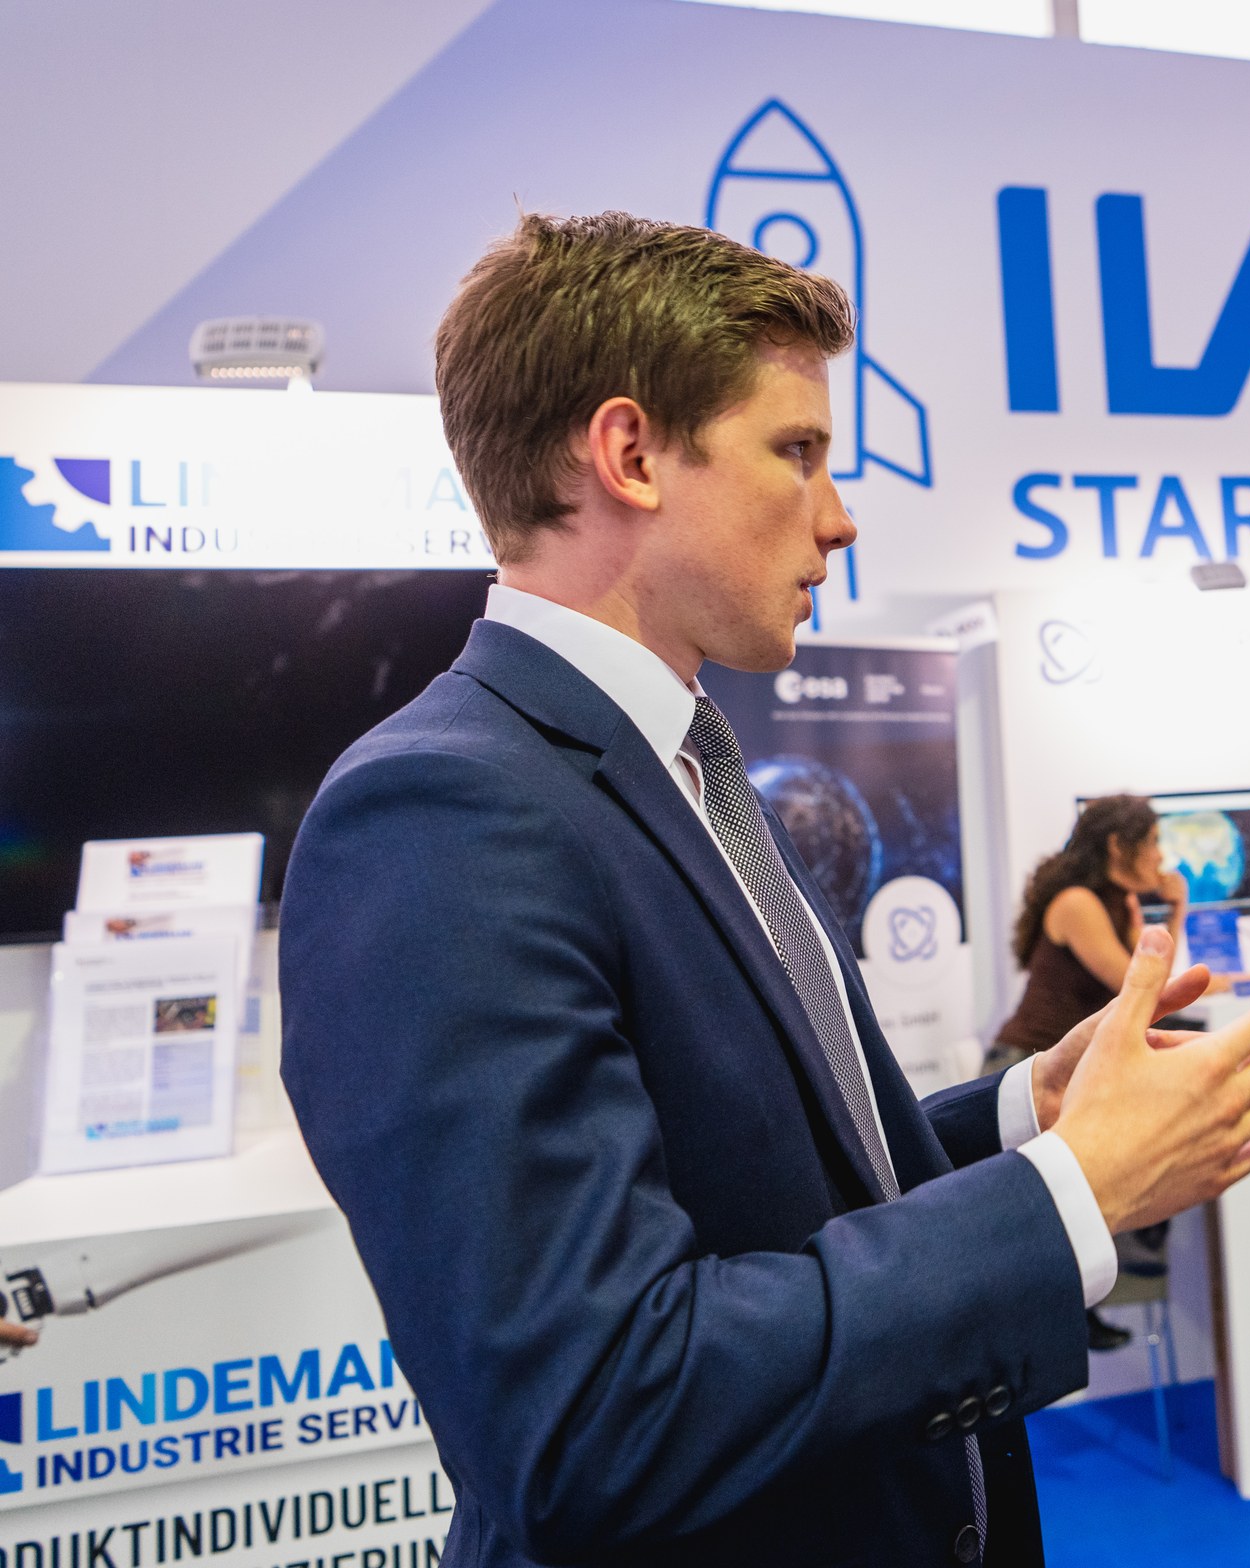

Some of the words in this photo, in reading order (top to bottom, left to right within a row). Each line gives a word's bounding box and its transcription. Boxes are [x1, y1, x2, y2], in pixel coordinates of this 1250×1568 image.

[37, 1418, 284, 1489] INDUSTRIE
[297, 1398, 421, 1445] SERVI
[0, 1471, 455, 1568] DUKTINDIVIDUELL
